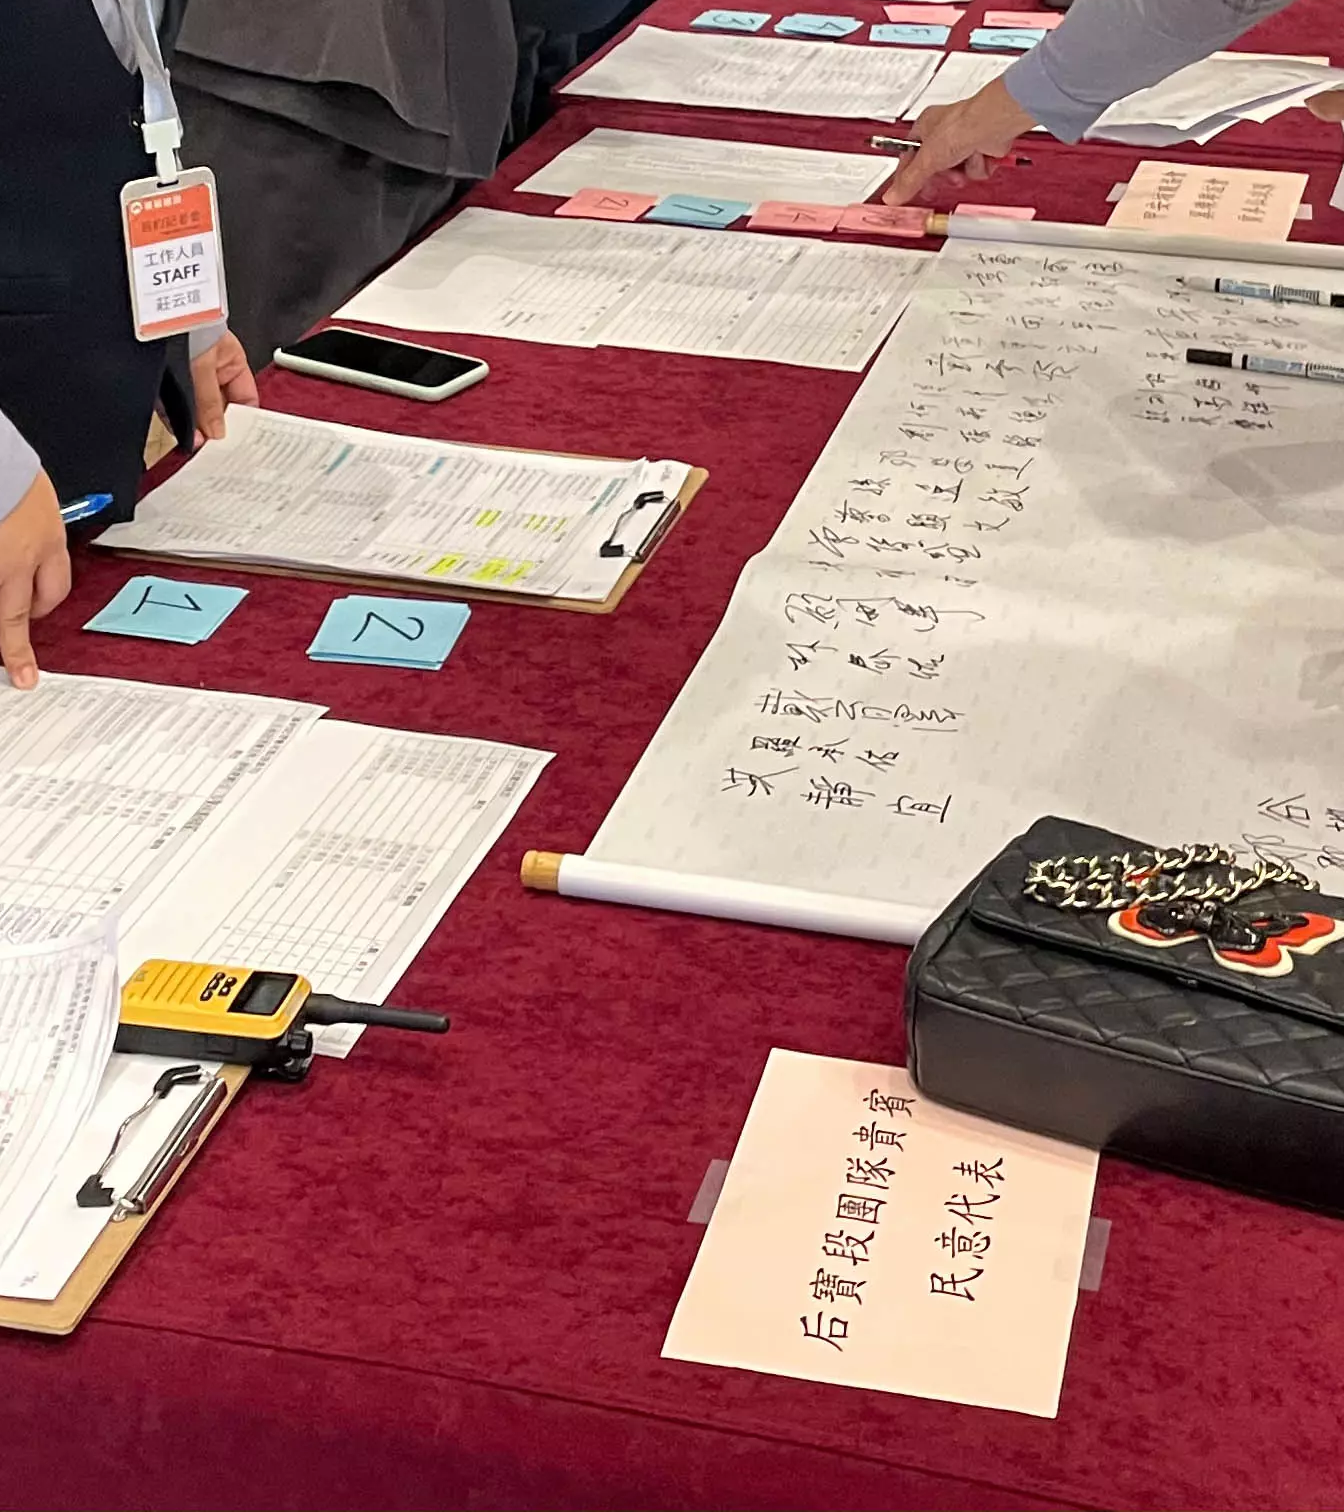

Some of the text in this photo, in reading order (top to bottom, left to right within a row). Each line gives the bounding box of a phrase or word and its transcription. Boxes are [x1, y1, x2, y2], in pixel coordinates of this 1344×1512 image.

[144, 242, 205, 268] 工作人員
[153, 263, 201, 286] STAFF
[131, 584, 204, 617] 1
[352, 609, 425, 644] 2
[799, 1087, 917, 1352] 后寶段團隊貴賓
[929, 1156, 1006, 1302] 民意代表
